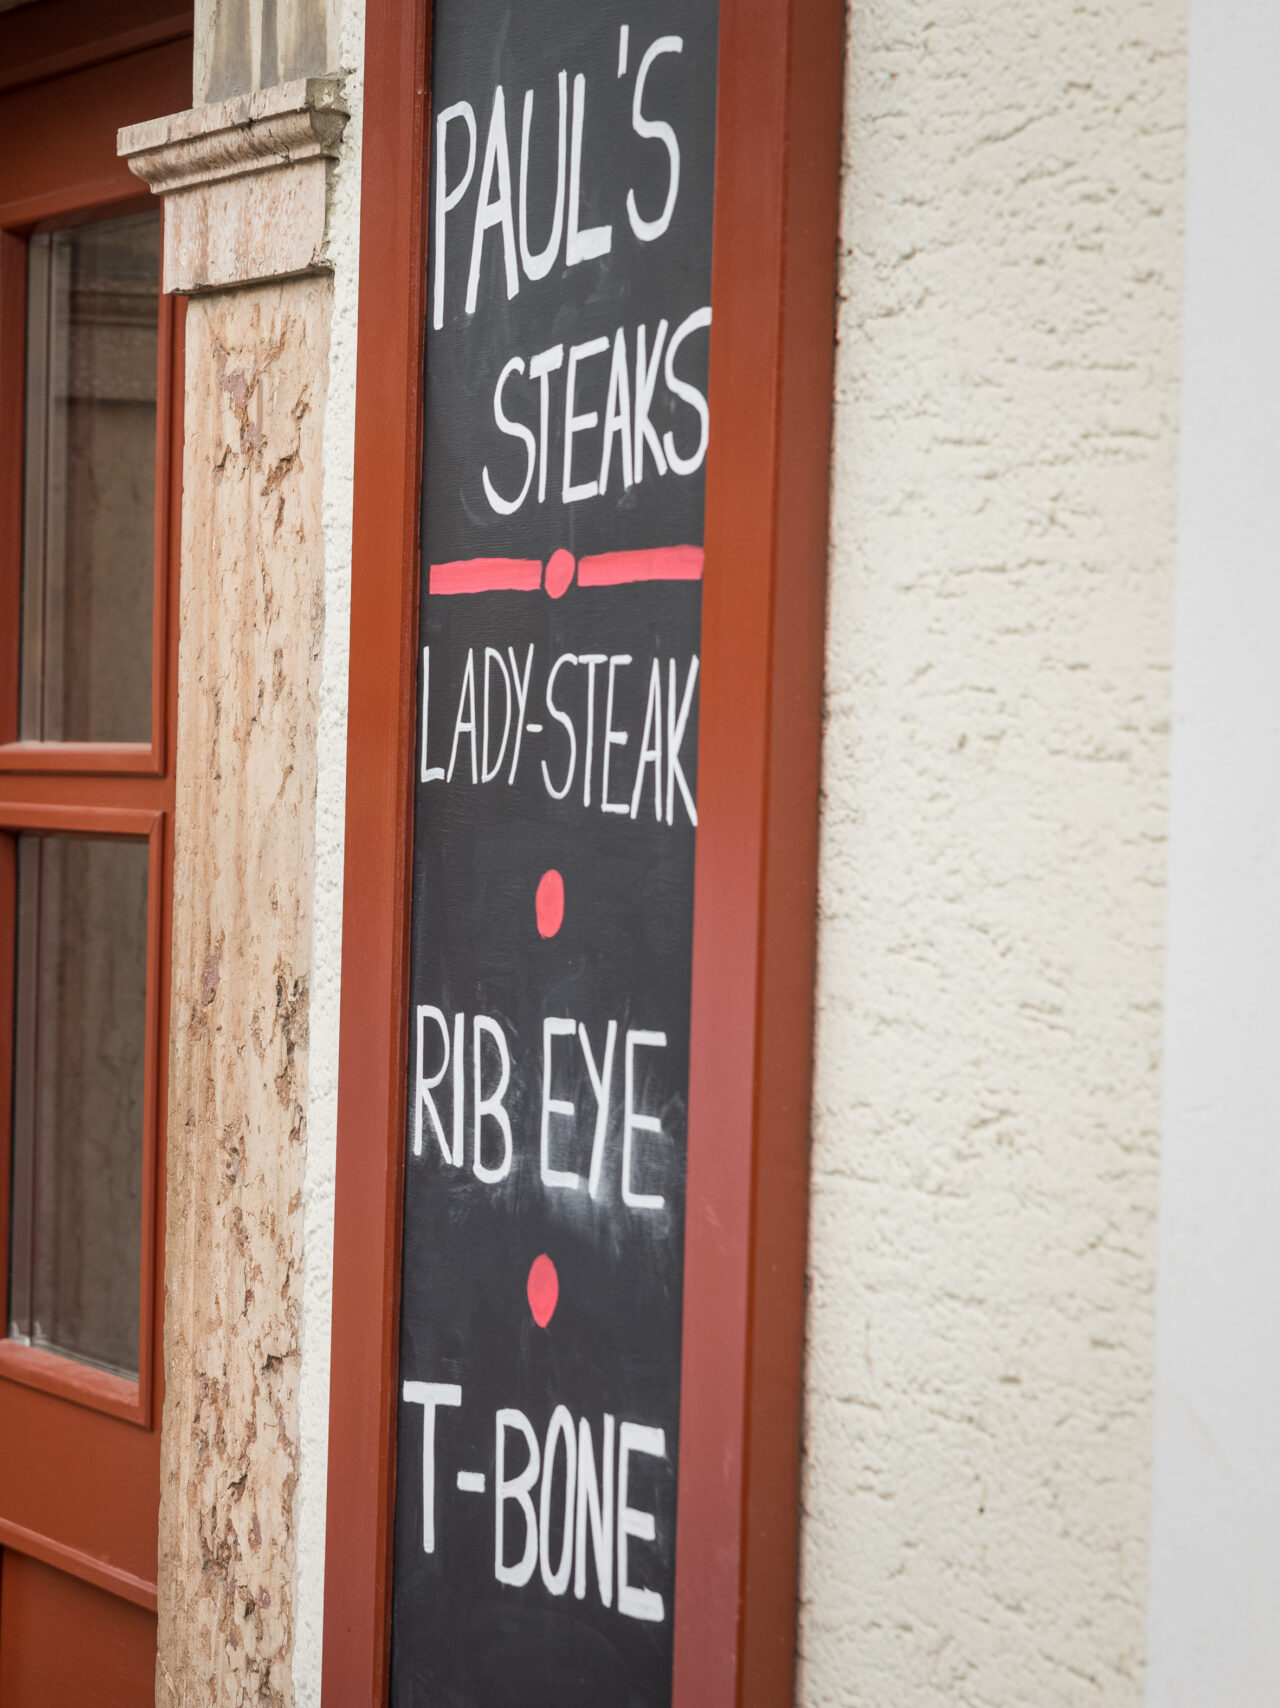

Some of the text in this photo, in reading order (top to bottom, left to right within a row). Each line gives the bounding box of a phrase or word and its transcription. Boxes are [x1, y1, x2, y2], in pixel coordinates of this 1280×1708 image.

[433, 25, 683, 330] PAUL'S
[483, 307, 713, 515] STEAKS
[421, 643, 700, 827] LADY-STEAK
[413, 1004, 667, 1209] RIB EYE
[403, 1380, 666, 1622] T-BONE
